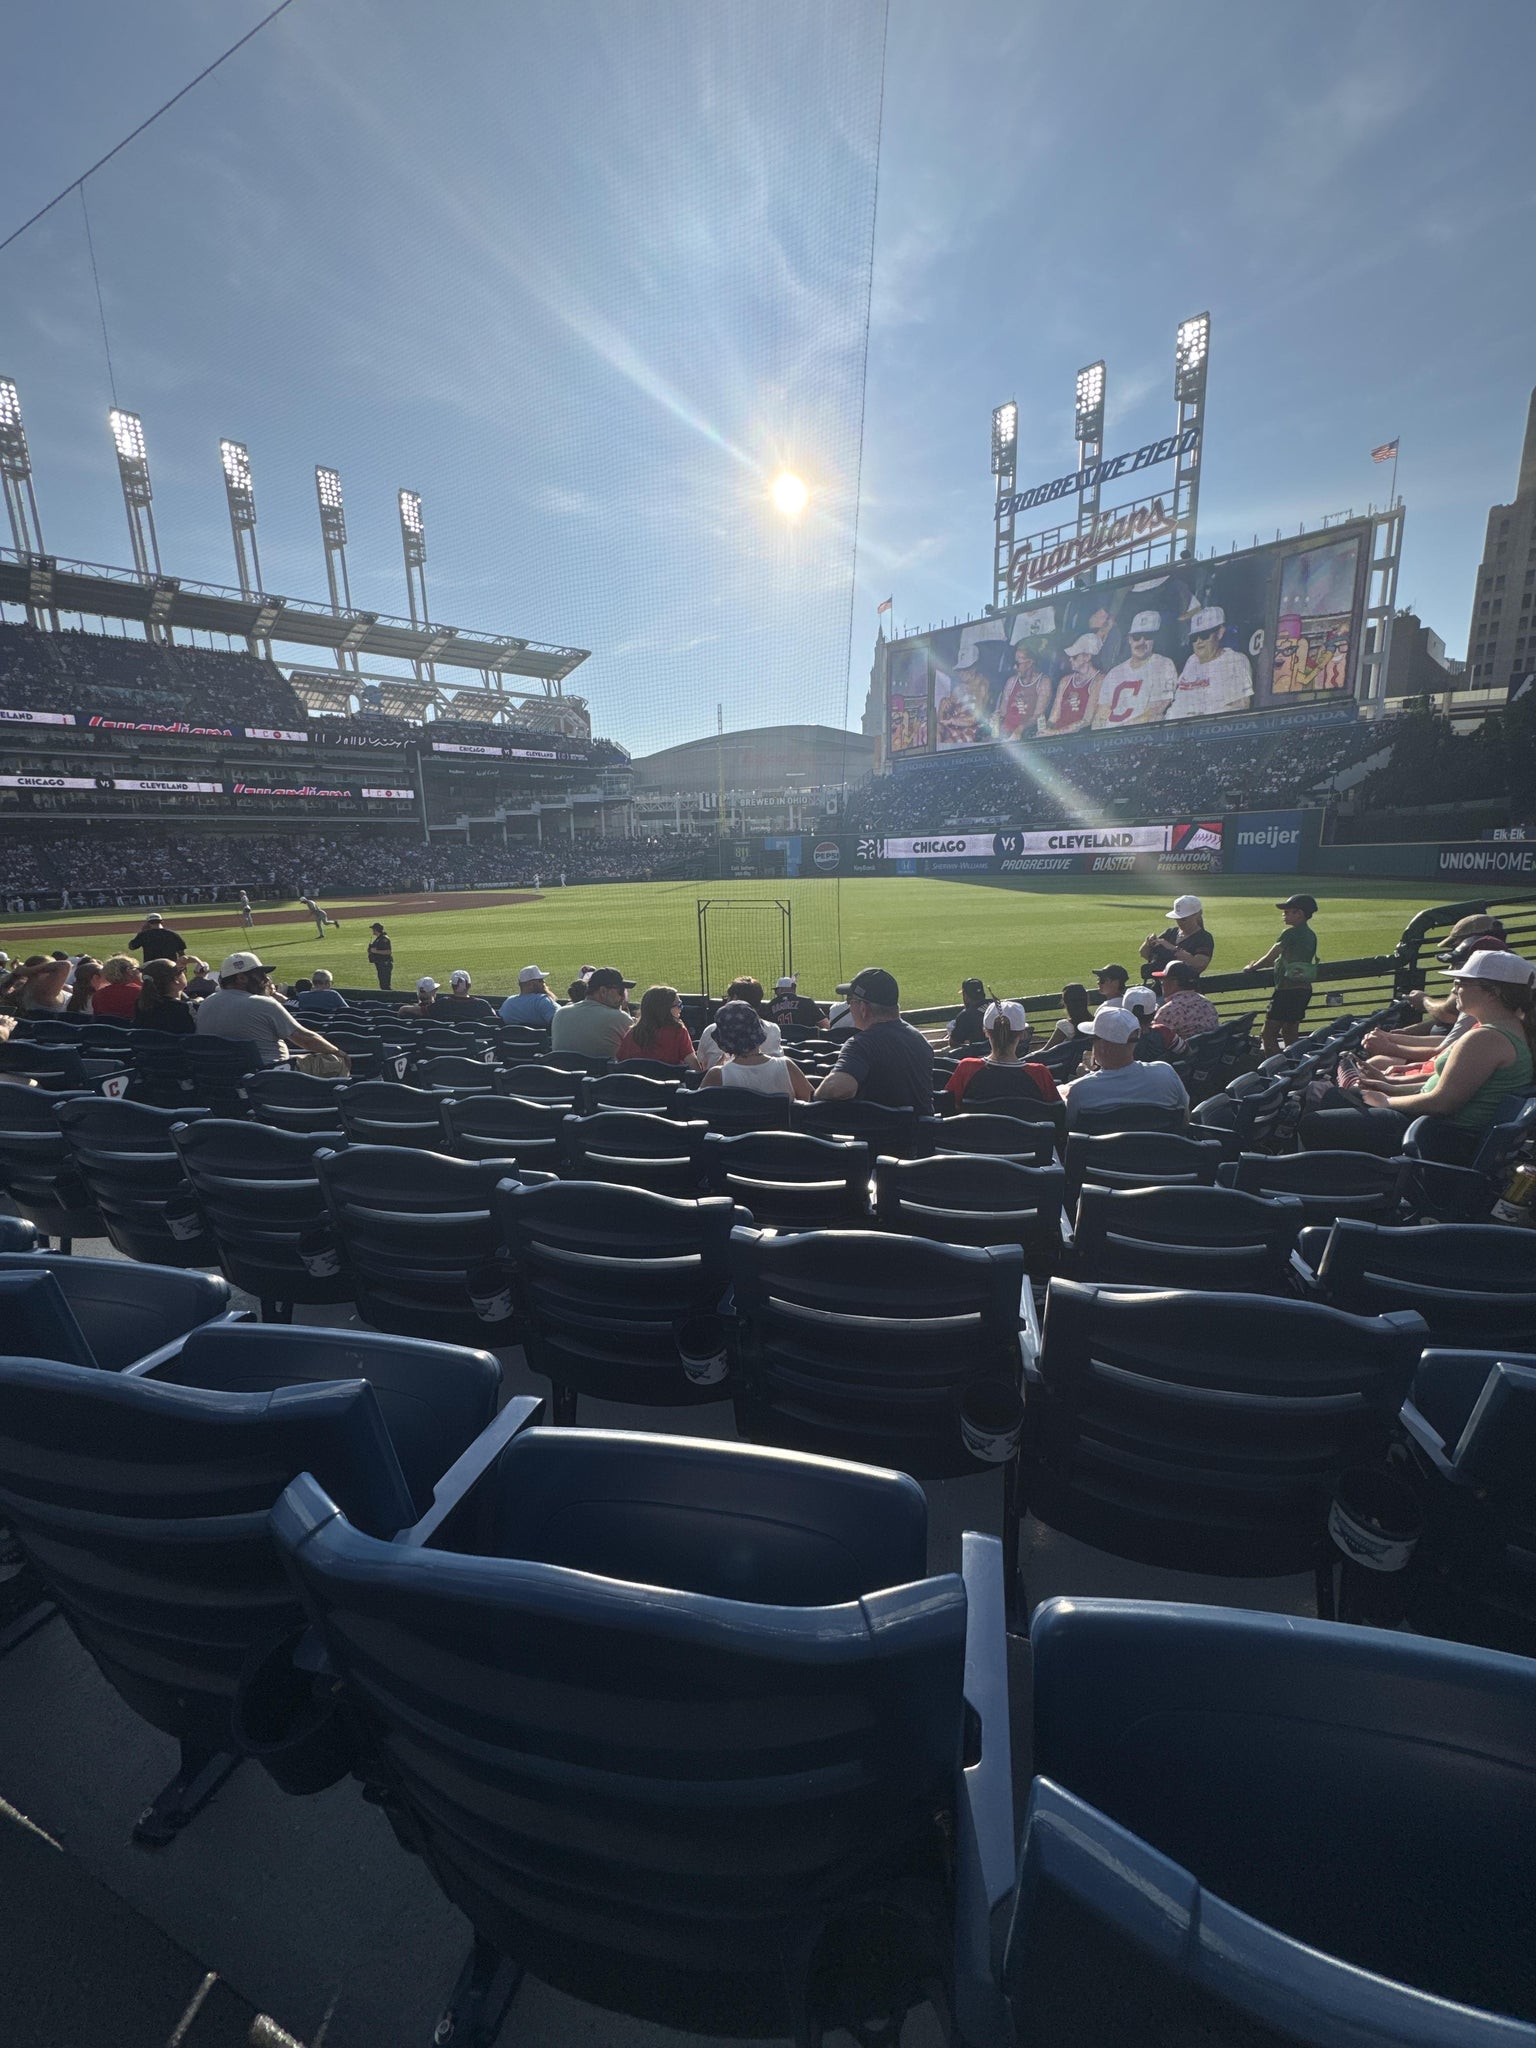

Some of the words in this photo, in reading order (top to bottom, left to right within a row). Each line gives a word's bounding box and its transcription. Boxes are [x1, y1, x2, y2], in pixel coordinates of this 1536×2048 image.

[994, 452, 1131, 520] PROGRESSIVE
[1132, 427, 1200, 472] FIELD
[1006, 497, 1178, 601] Guardians
[1109, 680, 1143, 722] C
[1280, 710, 1349, 726] HONDA
[1200, 721, 1259, 736] HONDA
[1103, 735, 1154, 746] HONDA
[951, 754, 990, 765] HONDA
[17, 778, 65, 787] CHICAGO
[100, 780, 110, 788] VS
[140, 782, 189, 790] CLEVELAND
[740, 797, 775, 807] BREWED
[776, 797, 786, 805] IN
[787, 796, 808, 804] OHIO
[1237, 826, 1300, 848] meijer
[1493, 828, 1508, 841] Elk
[1510, 827, 1526, 840] Elk
[912, 840, 967, 853] CHICAGO
[1001, 836, 1016, 851] VS
[1048, 833, 1134, 850] CLEVELAND
[815, 852, 839, 860] PEPSI
[1158, 853, 1211, 862] PHANTOM
[1000, 858, 1072, 871] PROGRESSIVE
[1092, 856, 1136, 871] BLASTER
[1157, 863, 1209, 871] FIREWORKS
[109, 1081, 120, 1097] C
